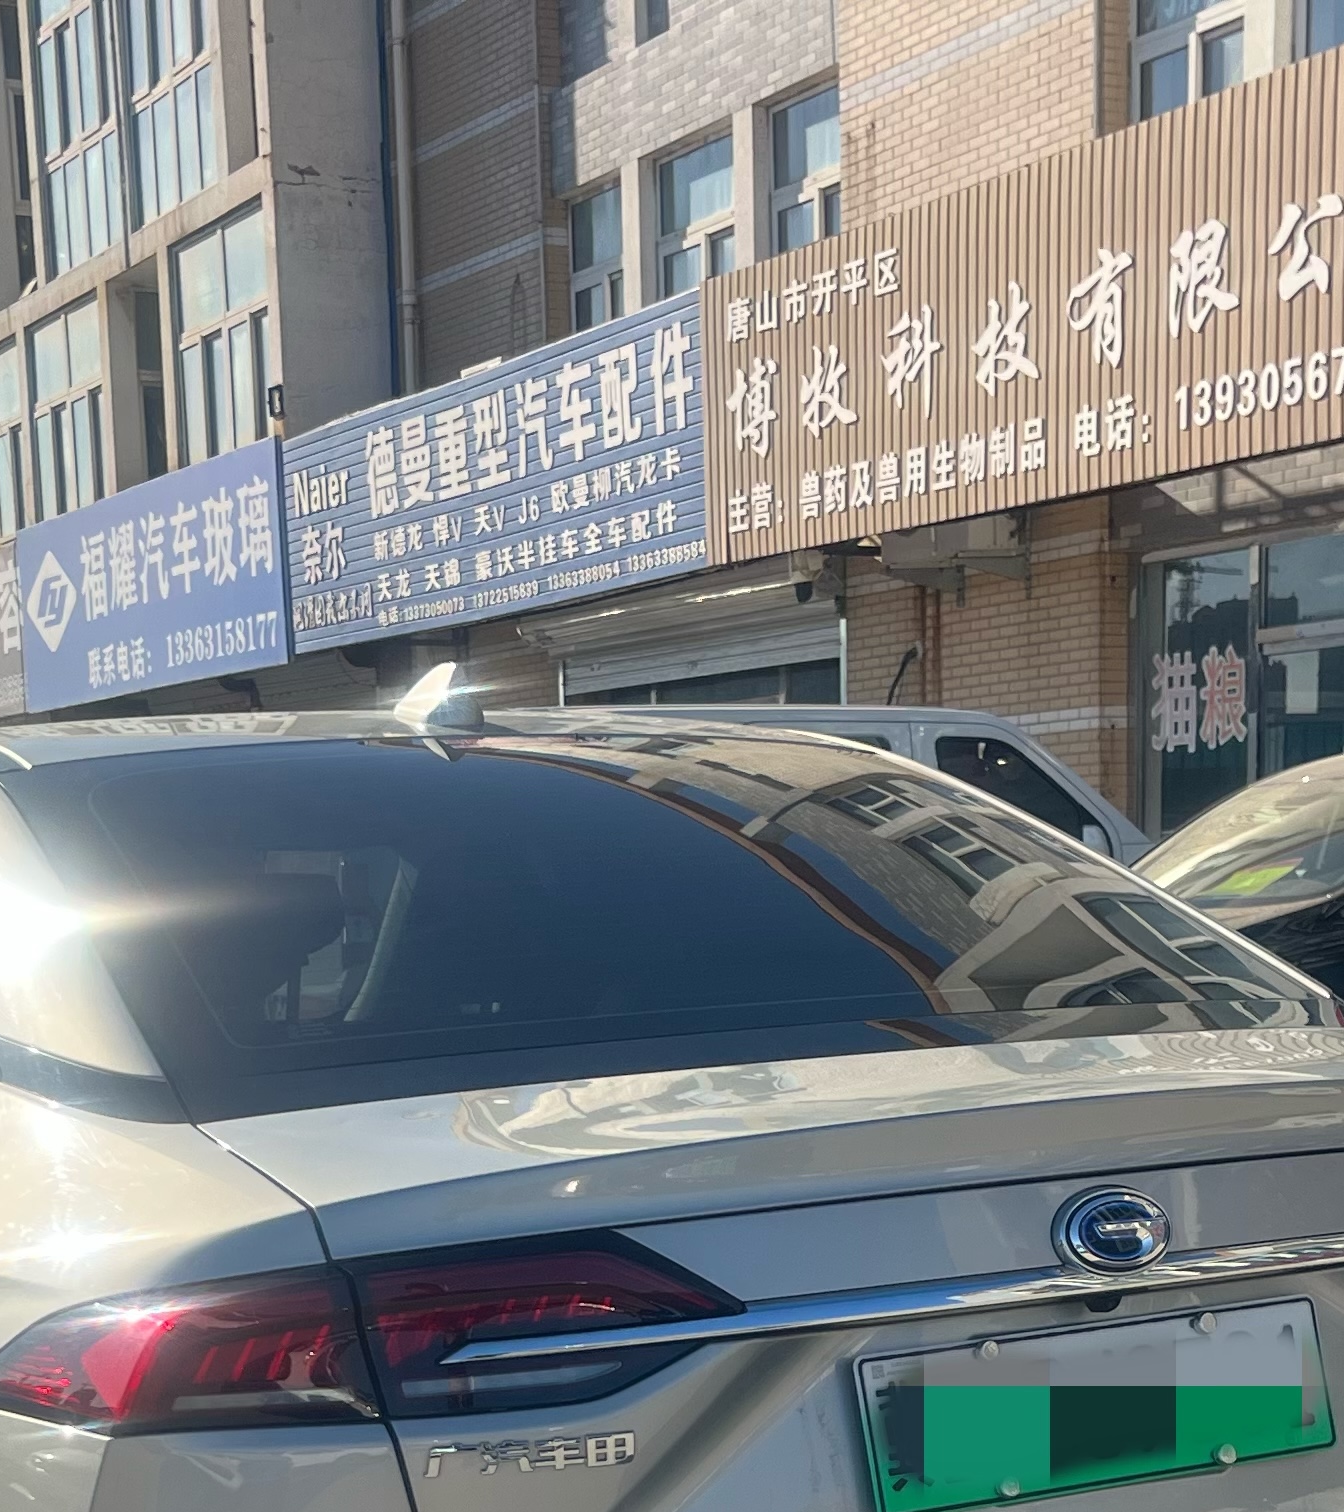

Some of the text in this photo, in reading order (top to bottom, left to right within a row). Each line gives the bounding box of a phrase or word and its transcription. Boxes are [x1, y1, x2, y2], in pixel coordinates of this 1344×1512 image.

[725, 247, 902, 344] 唐山市开平区
[365, 321, 694, 520] 德曼重型汽车配件
[293, 464, 350, 518] Naier
[373, 523, 424, 562] 新德龙
[474, 504, 505, 536] 天V
[518, 495, 540, 524] J6
[80, 474, 273, 623] 福耀汽车玻璃
[301, 521, 346, 585] 奈尔
[377, 568, 412, 602] 天龙
[474, 499, 677, 582] 豪沃半挂车全车配件
[1152, 643, 1247, 754] 猫粮
[423, 1430, 636, 1479] 广汽丰田
